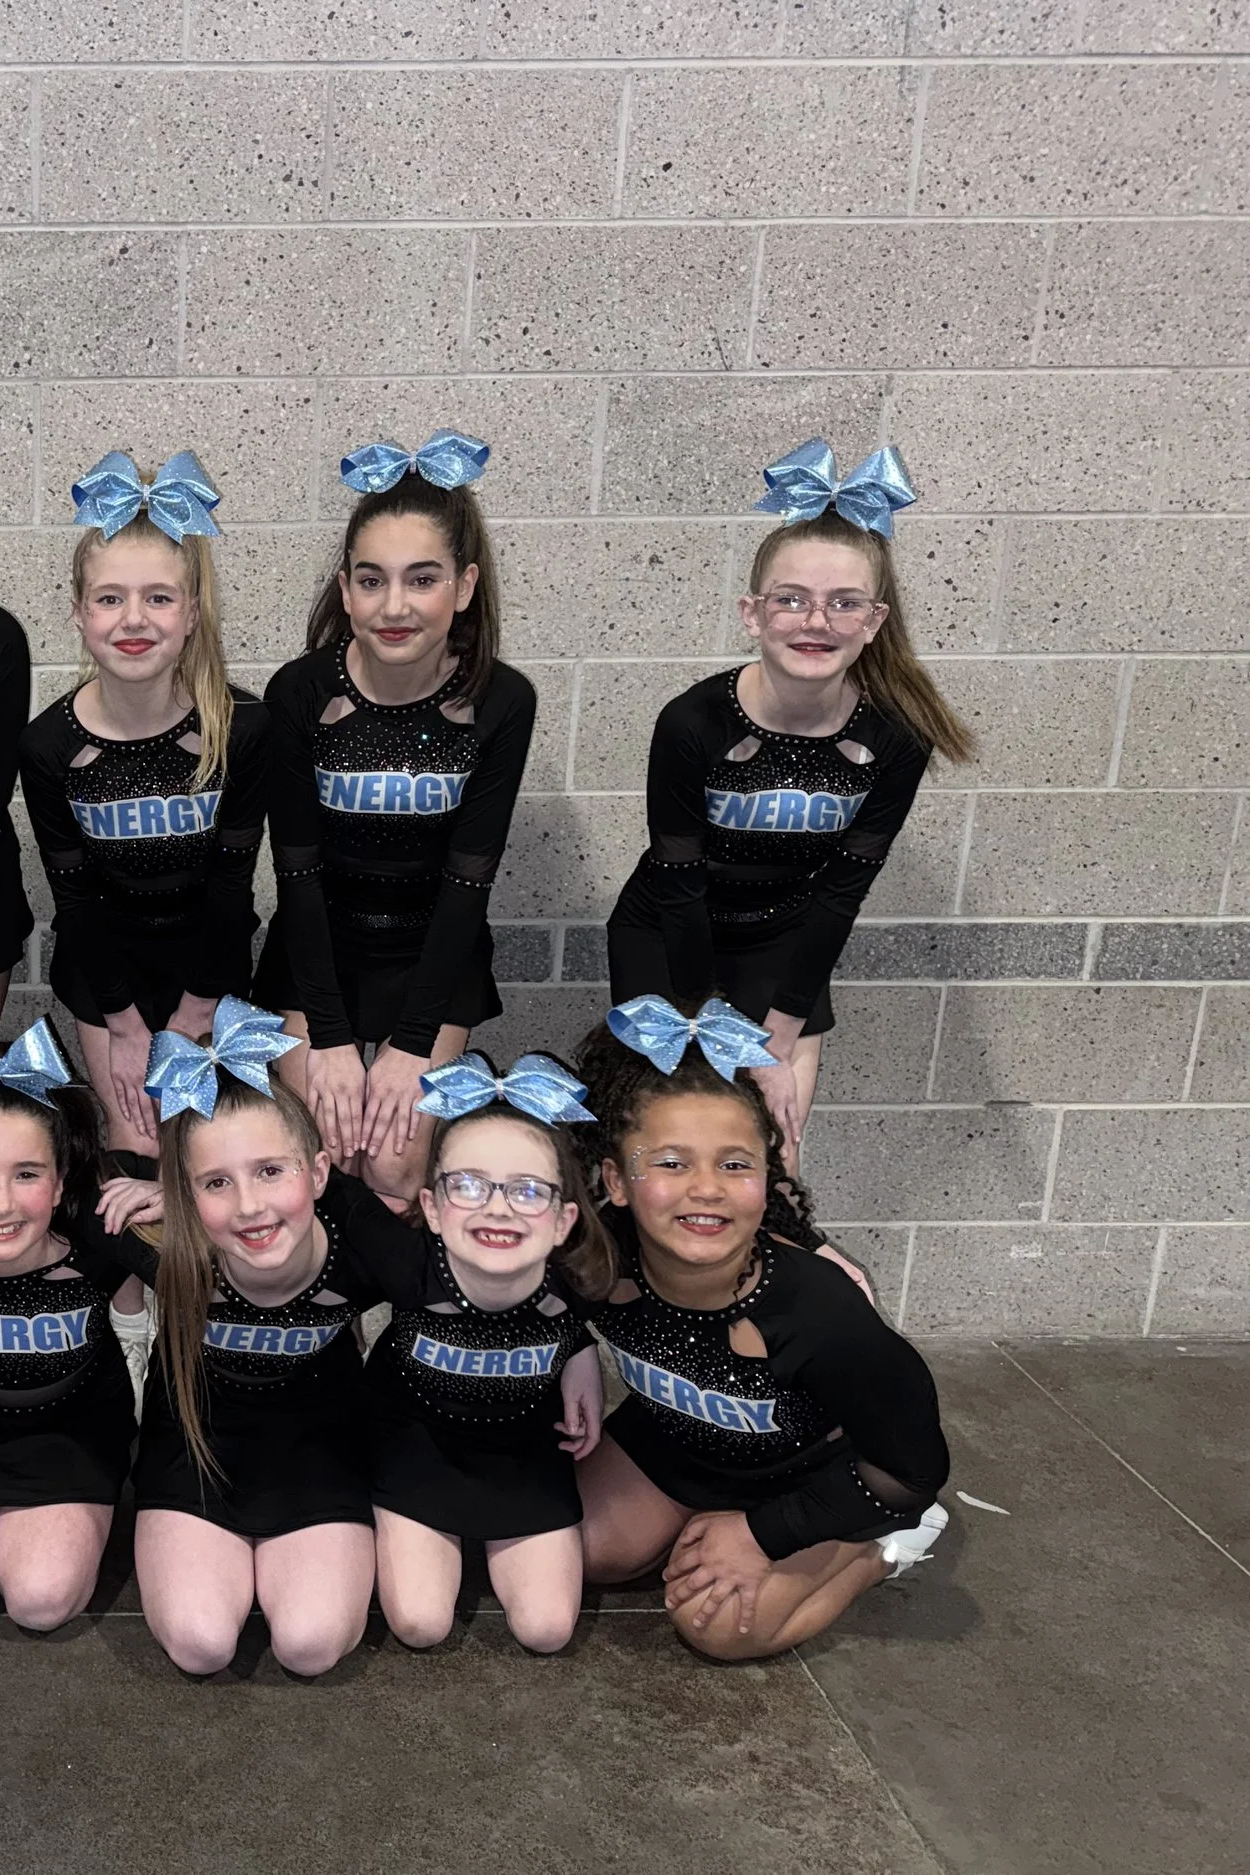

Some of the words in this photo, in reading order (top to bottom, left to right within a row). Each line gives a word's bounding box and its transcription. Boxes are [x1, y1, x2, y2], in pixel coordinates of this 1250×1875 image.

[317, 770, 466, 813] ENERGY
[701, 791, 864, 831] ENERGY
[72, 793, 220, 838] ENERGY
[204, 1321, 341, 1354] NERGY
[413, 1337, 556, 1376] ENERGY
